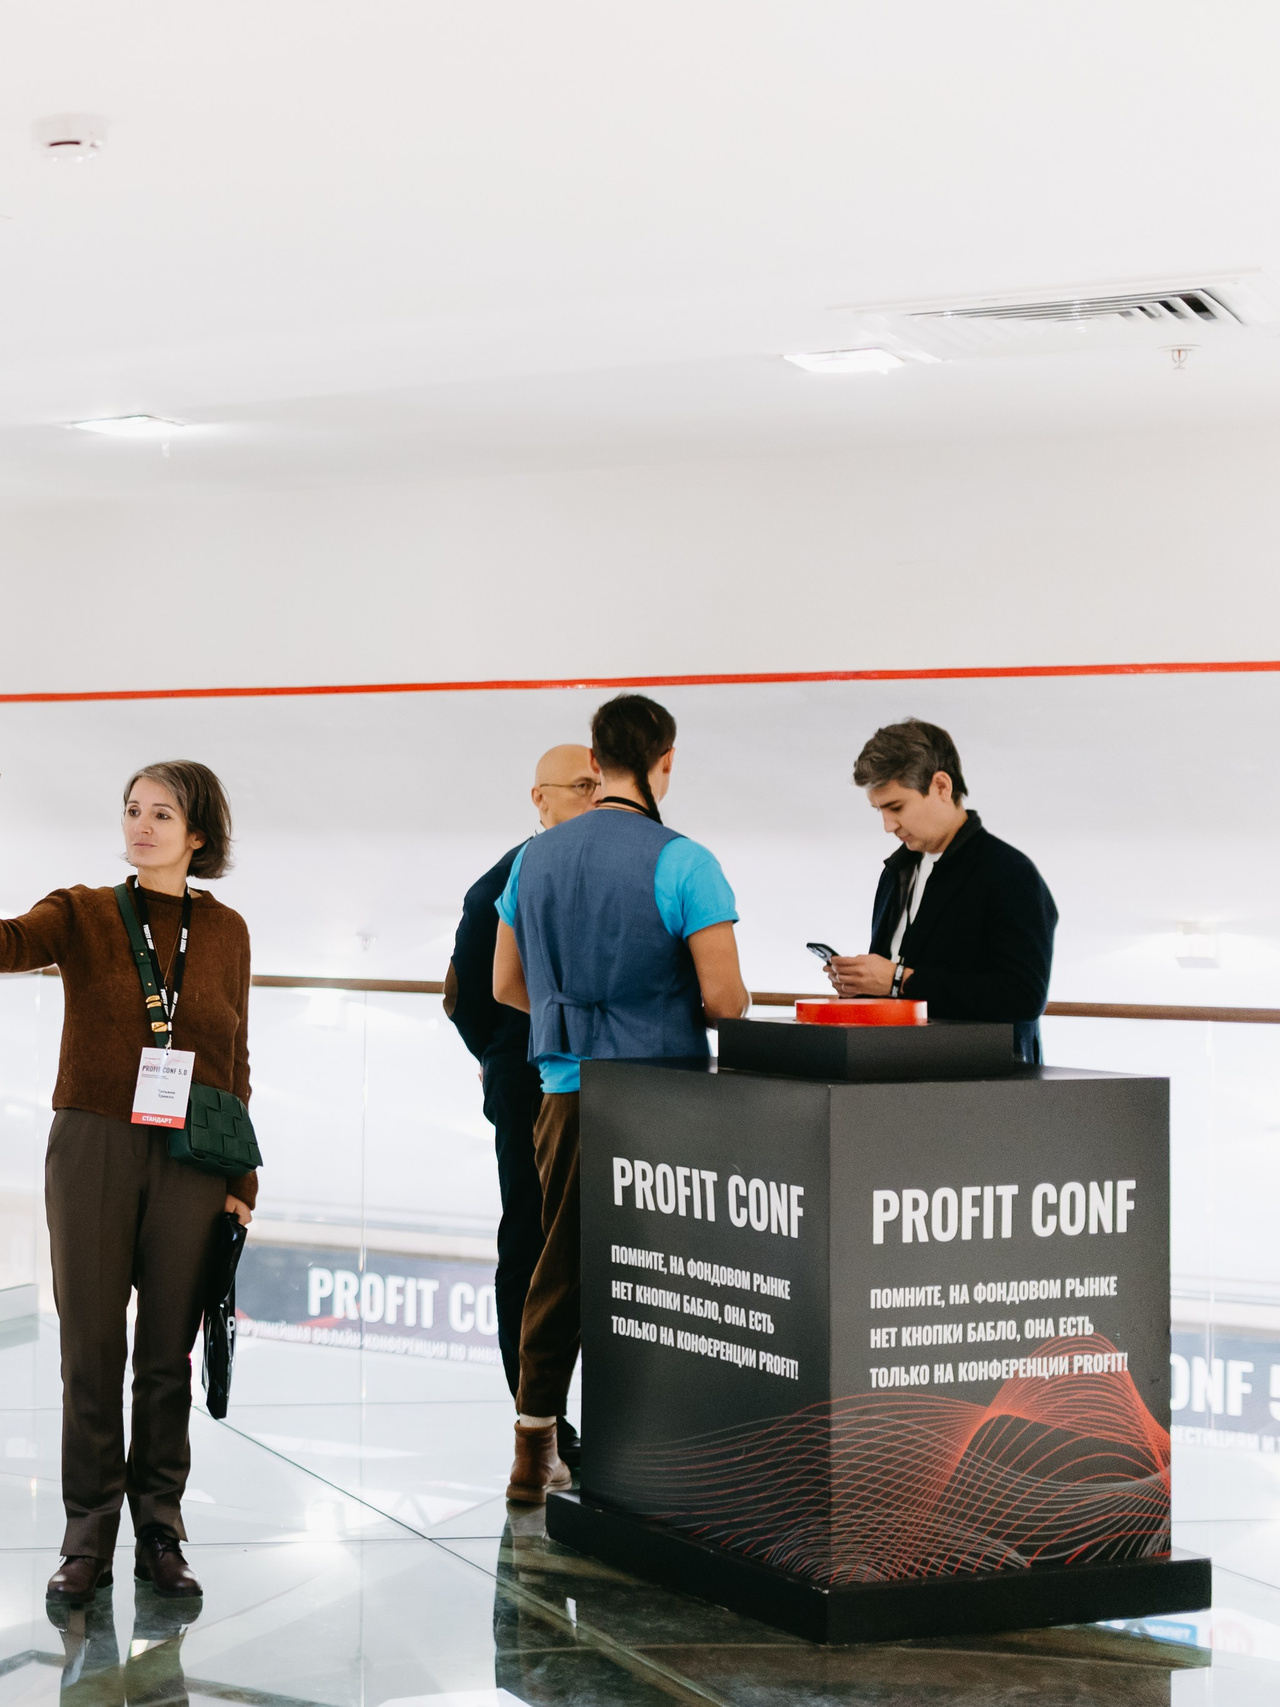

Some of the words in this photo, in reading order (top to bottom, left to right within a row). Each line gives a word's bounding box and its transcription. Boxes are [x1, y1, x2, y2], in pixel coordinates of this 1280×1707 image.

[142, 1065, 161, 1073] PROFIT
[162, 1067, 177, 1075] CONF
[141, 1115, 173, 1124] СТАНДАРТ
[612, 1156, 718, 1222] PROFIT
[727, 1174, 805, 1239] CONF
[872, 1185, 1019, 1245] PROFIT
[1031, 1179, 1137, 1238] CONF
[611, 1244, 668, 1275] ПОМНИТЕ,
[669, 1255, 685, 1276] НА
[686, 1258, 751, 1290] ФОНДОВОМ
[753, 1273, 791, 1300] РЫНКЕ
[870, 1285, 946, 1309] ПОМНИТЕ,
[949, 1284, 970, 1305] НА
[973, 1279, 1061, 1305] ФОНДОВОМ
[1065, 1276, 1118, 1298] РЫНКЕ
[307, 1266, 440, 1329] PROFIT
[611, 1280, 633, 1301] НЕТ
[635, 1284, 681, 1312] КНОПКИ
[682, 1294, 722, 1324] БАБЛО,
[724, 1304, 747, 1328] ОНА
[748, 1310, 775, 1335] ЕСТЬ
[237, 1319, 311, 1343] КРУПНЕЙШАЯ
[448, 1342, 466, 1361] ПО
[611, 1315, 658, 1343] ТОЛЬКО
[659, 1325, 675, 1347] НА
[676, 1330, 757, 1369] КОНФЕРЕНЦИИ
[758, 1350, 799, 1381] PROFIT!
[870, 1327, 898, 1348] НЕТ
[901, 1323, 963, 1347] КНОПКИ
[966, 1319, 1021, 1343] БАБЛО,
[1024, 1318, 1055, 1339] ОНА
[1059, 1315, 1095, 1337] ЕСТЬ
[869, 1364, 930, 1388] ТОЛЬКО
[933, 1362, 955, 1384] НА
[957, 1354, 1069, 1382] КОНФЕРЕНЦИИ
[1072, 1352, 1129, 1375] PROFIT!
